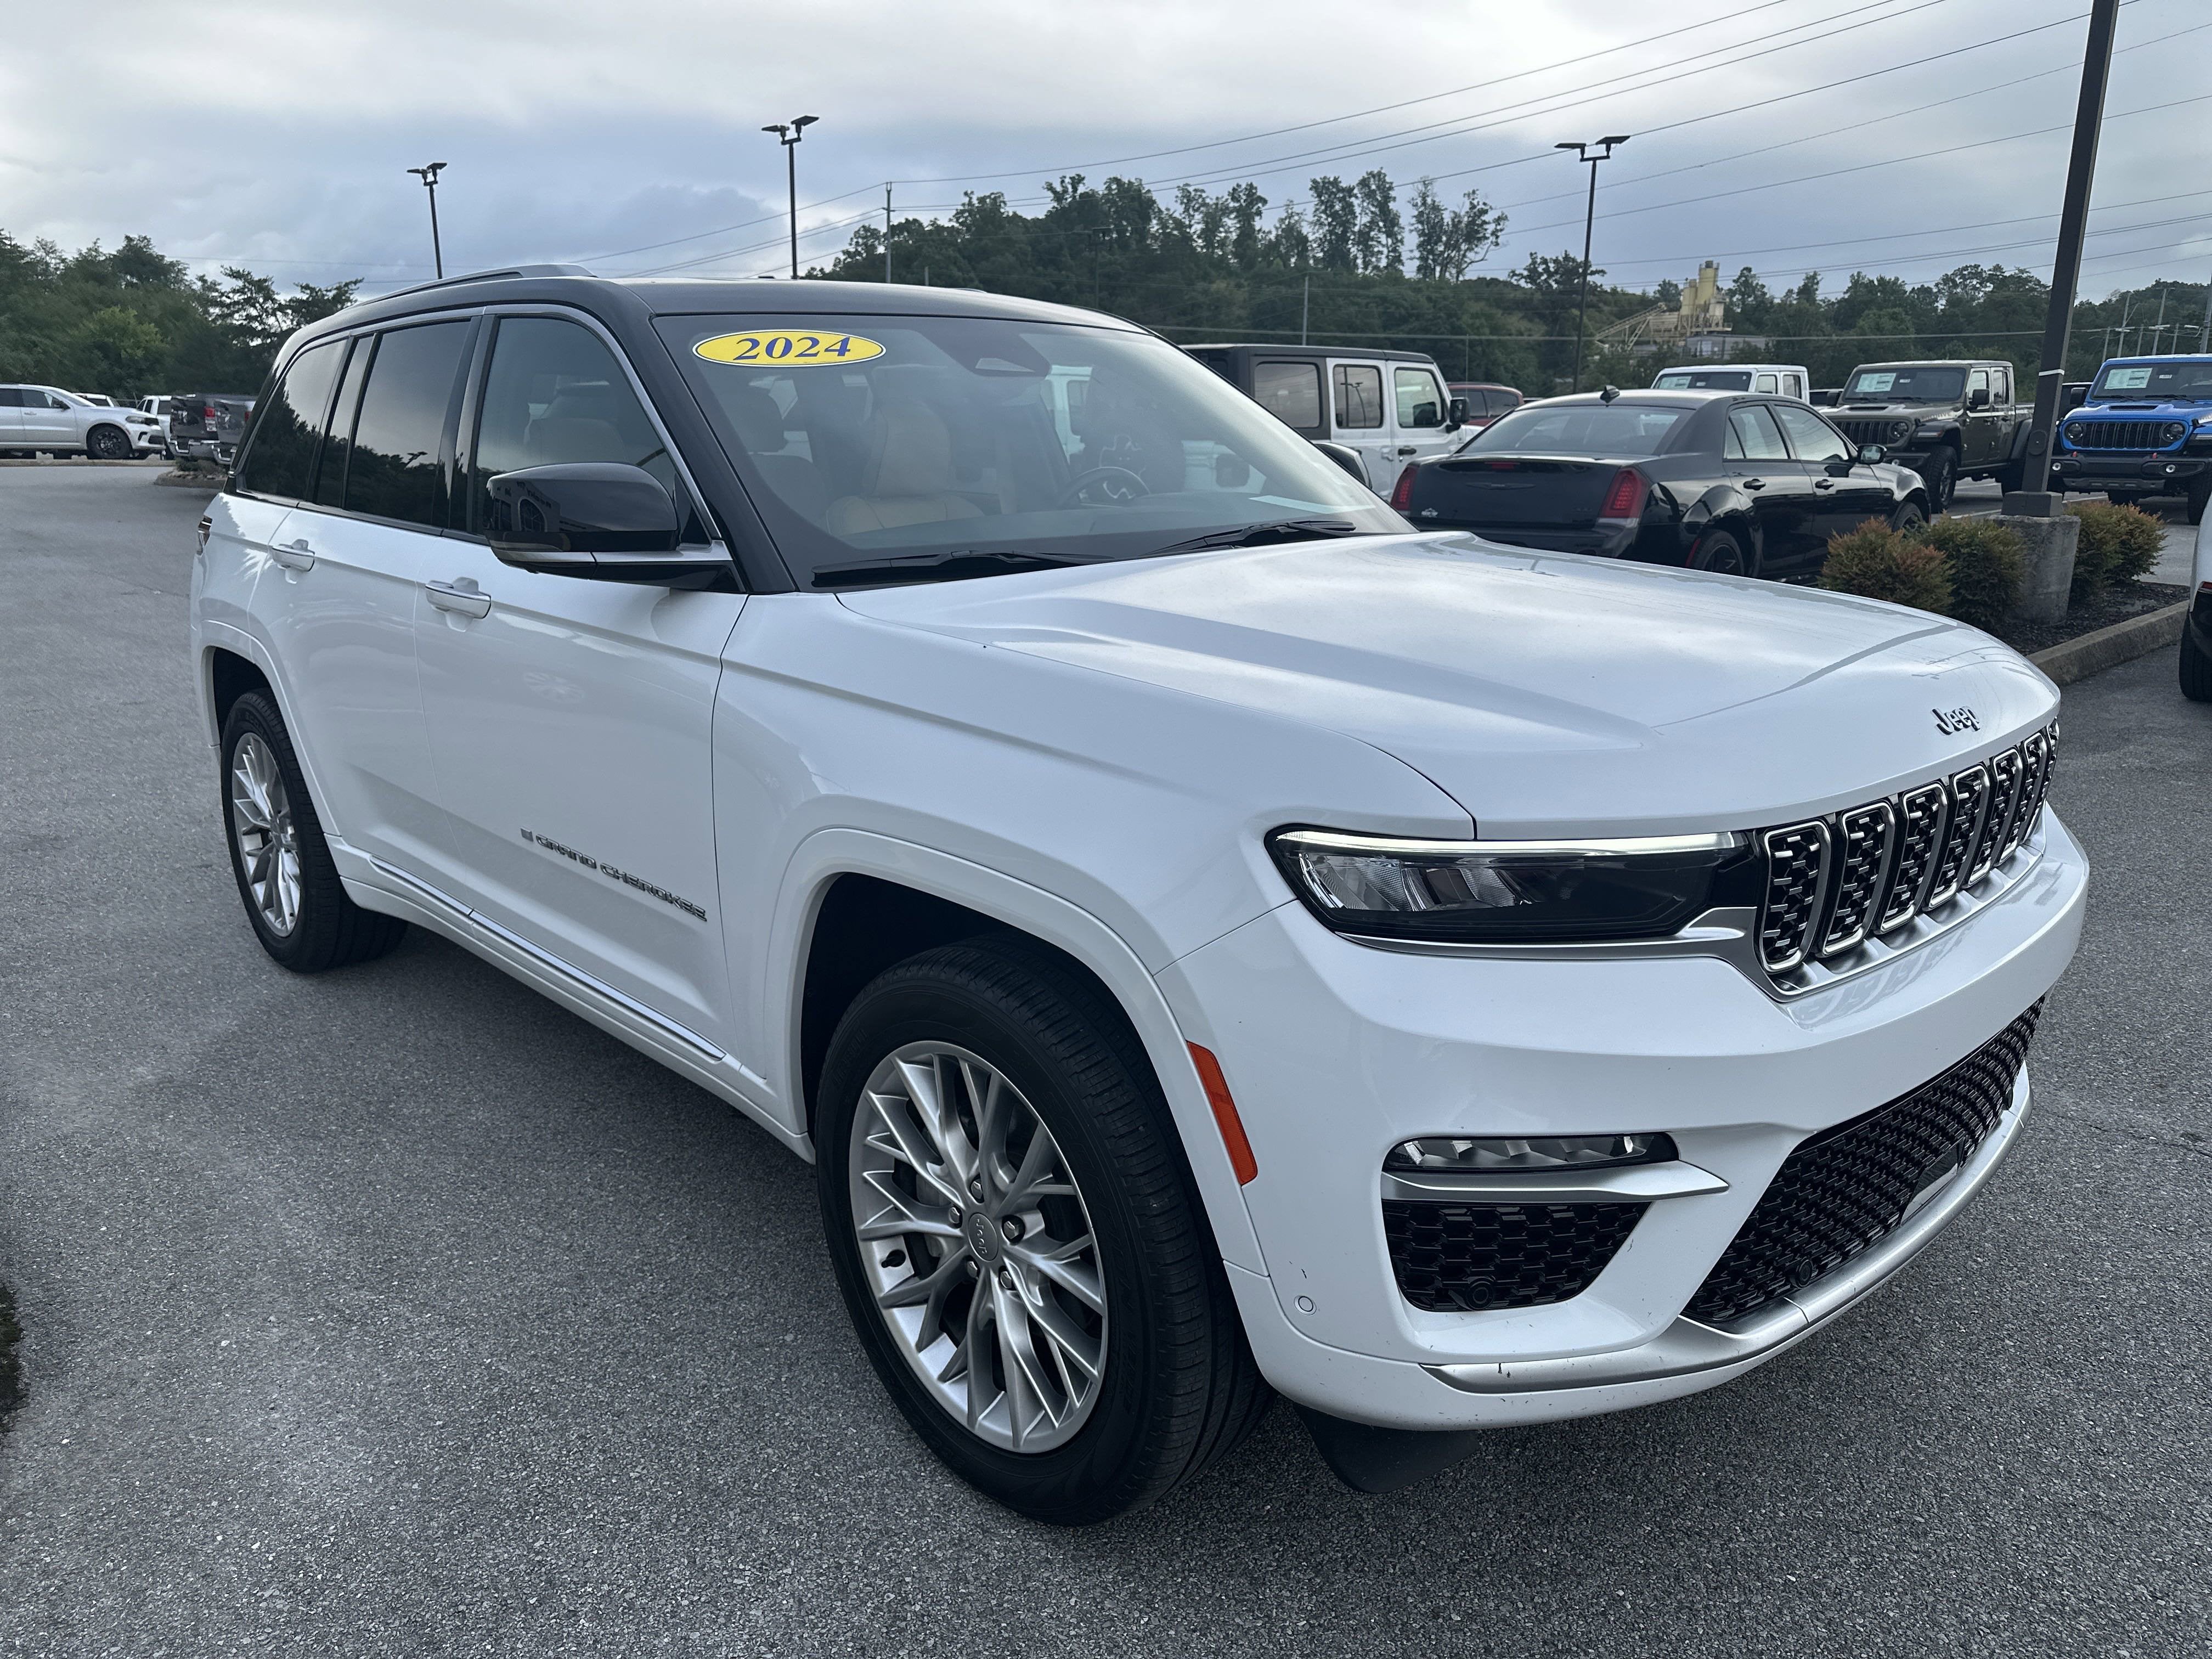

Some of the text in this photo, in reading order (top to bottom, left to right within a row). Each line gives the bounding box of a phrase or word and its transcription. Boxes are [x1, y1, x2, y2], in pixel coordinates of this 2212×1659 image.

[732, 336, 851, 360] 2024
[1931, 706, 1981, 735] Jeep
[535, 833, 708, 922] GRAND CHEROKEE
[976, 1218, 988, 1254] Jeep
